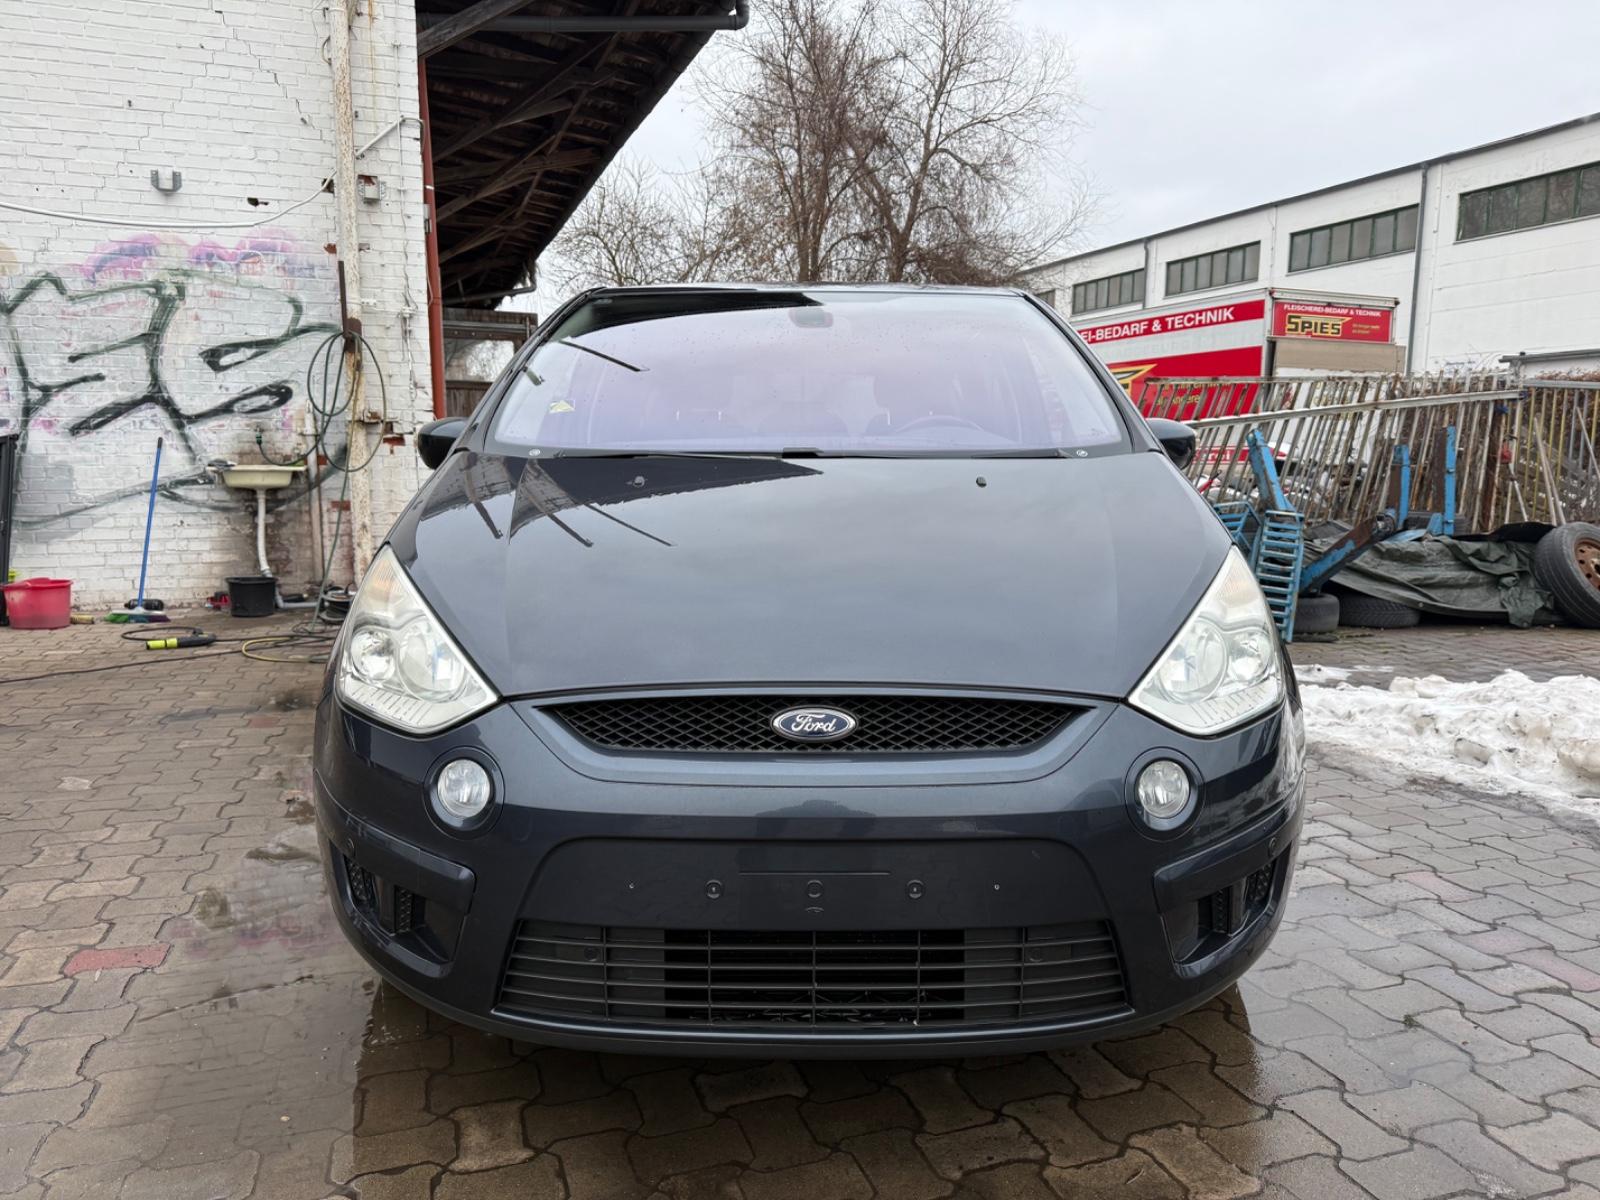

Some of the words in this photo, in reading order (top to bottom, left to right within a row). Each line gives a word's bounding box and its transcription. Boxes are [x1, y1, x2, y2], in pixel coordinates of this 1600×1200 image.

[1151, 319, 1162, 332] &
[1165, 307, 1235, 329] TECHNIK
[1286, 314, 1342, 336] SPIES
[791, 713, 837, 732] Ford
